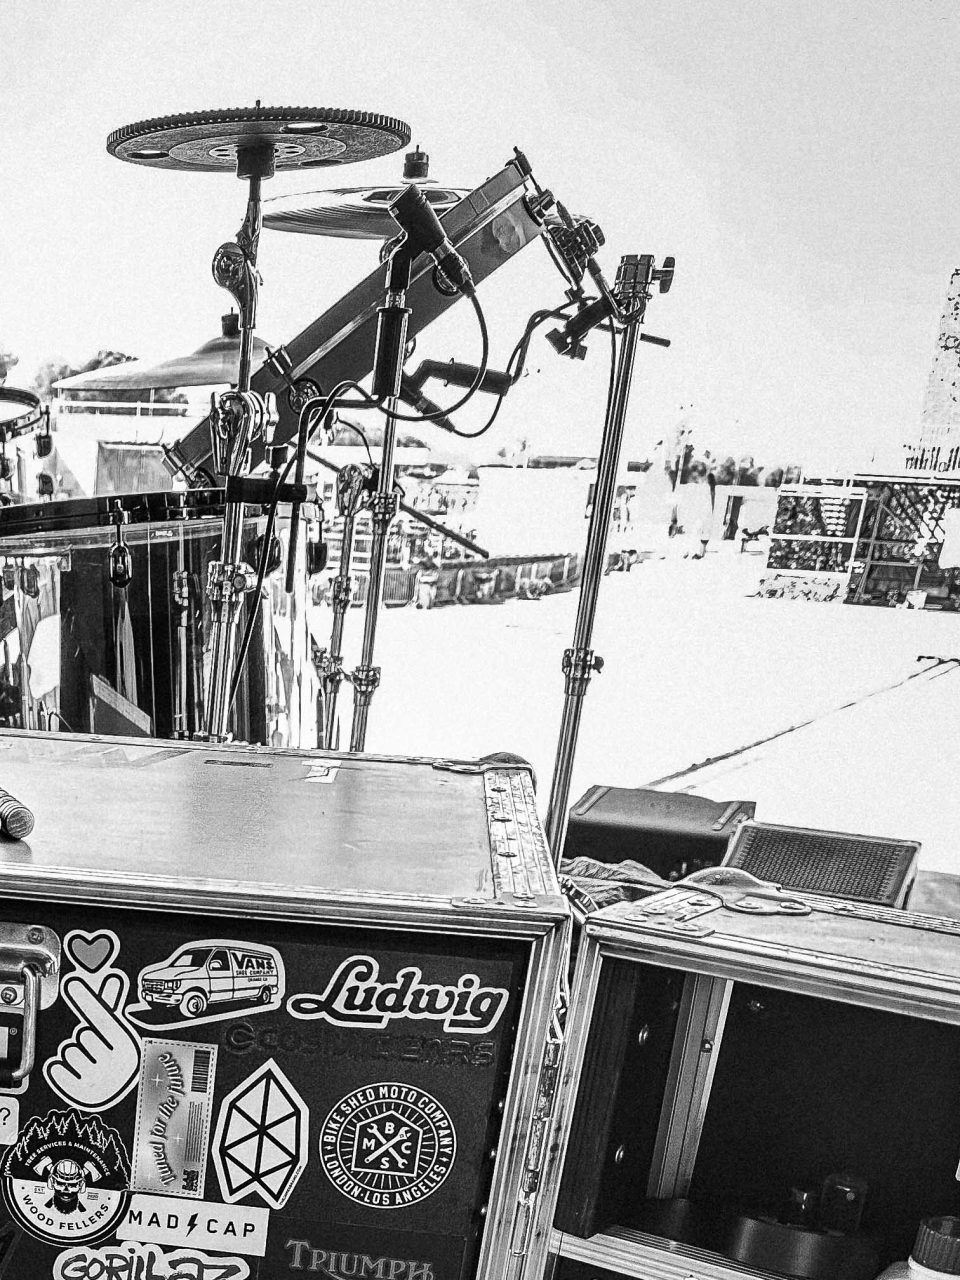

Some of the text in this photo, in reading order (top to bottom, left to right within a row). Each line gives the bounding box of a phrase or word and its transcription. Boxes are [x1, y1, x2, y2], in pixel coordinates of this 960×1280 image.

[231, 952, 275, 969] VANS
[291, 959, 504, 1028] Ludwig
[324, 1087, 452, 1154] BIKE SHED MOTO COMPANY
[37, 1141, 67, 1153] SERVICES
[74, 1143, 111, 1176] MAINTENANCE
[396, 1165, 447, 1204] ANGELES
[23, 1195, 109, 1231] WOOD FELLERS
[129, 1211, 256, 1238] MAD CAP
